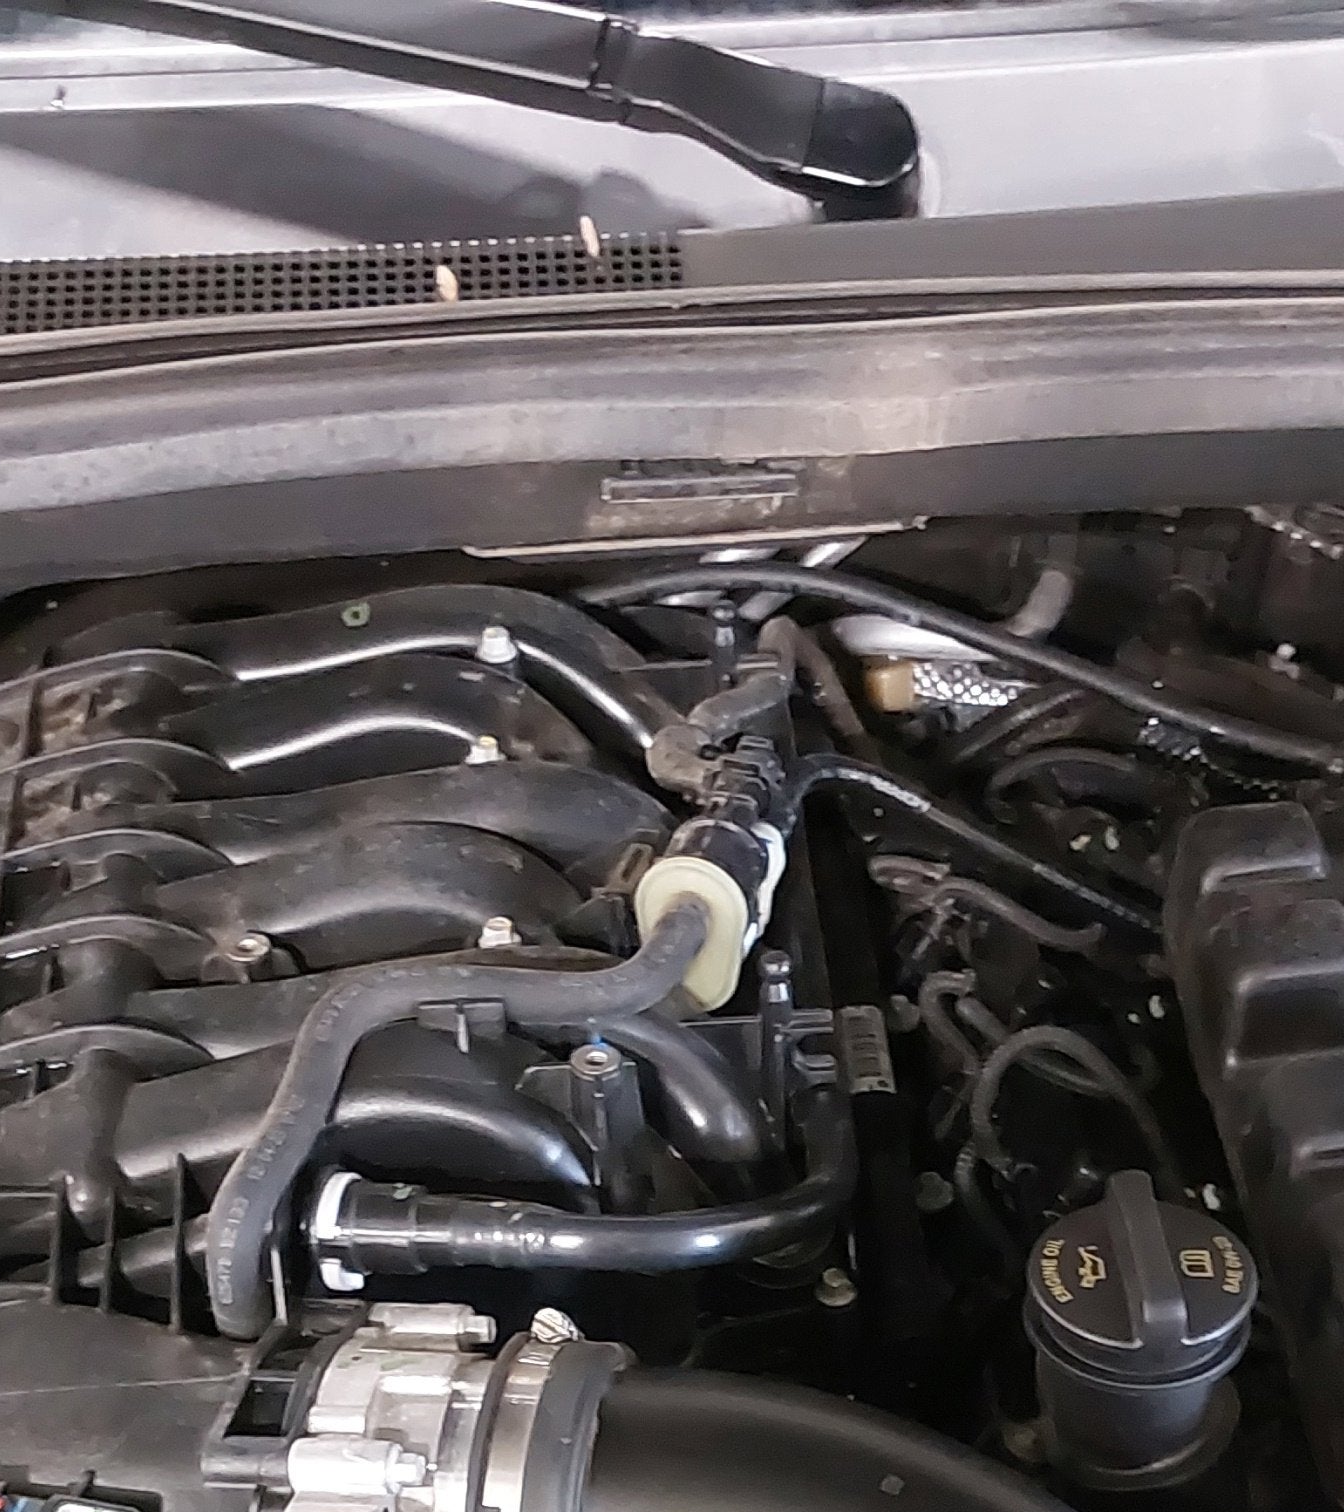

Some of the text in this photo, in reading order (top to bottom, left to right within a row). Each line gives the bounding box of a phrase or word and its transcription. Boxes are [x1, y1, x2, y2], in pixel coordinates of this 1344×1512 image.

[1041, 1240, 1073, 1303] ENGINE OIL
[1222, 1269, 1243, 1294] SAE
